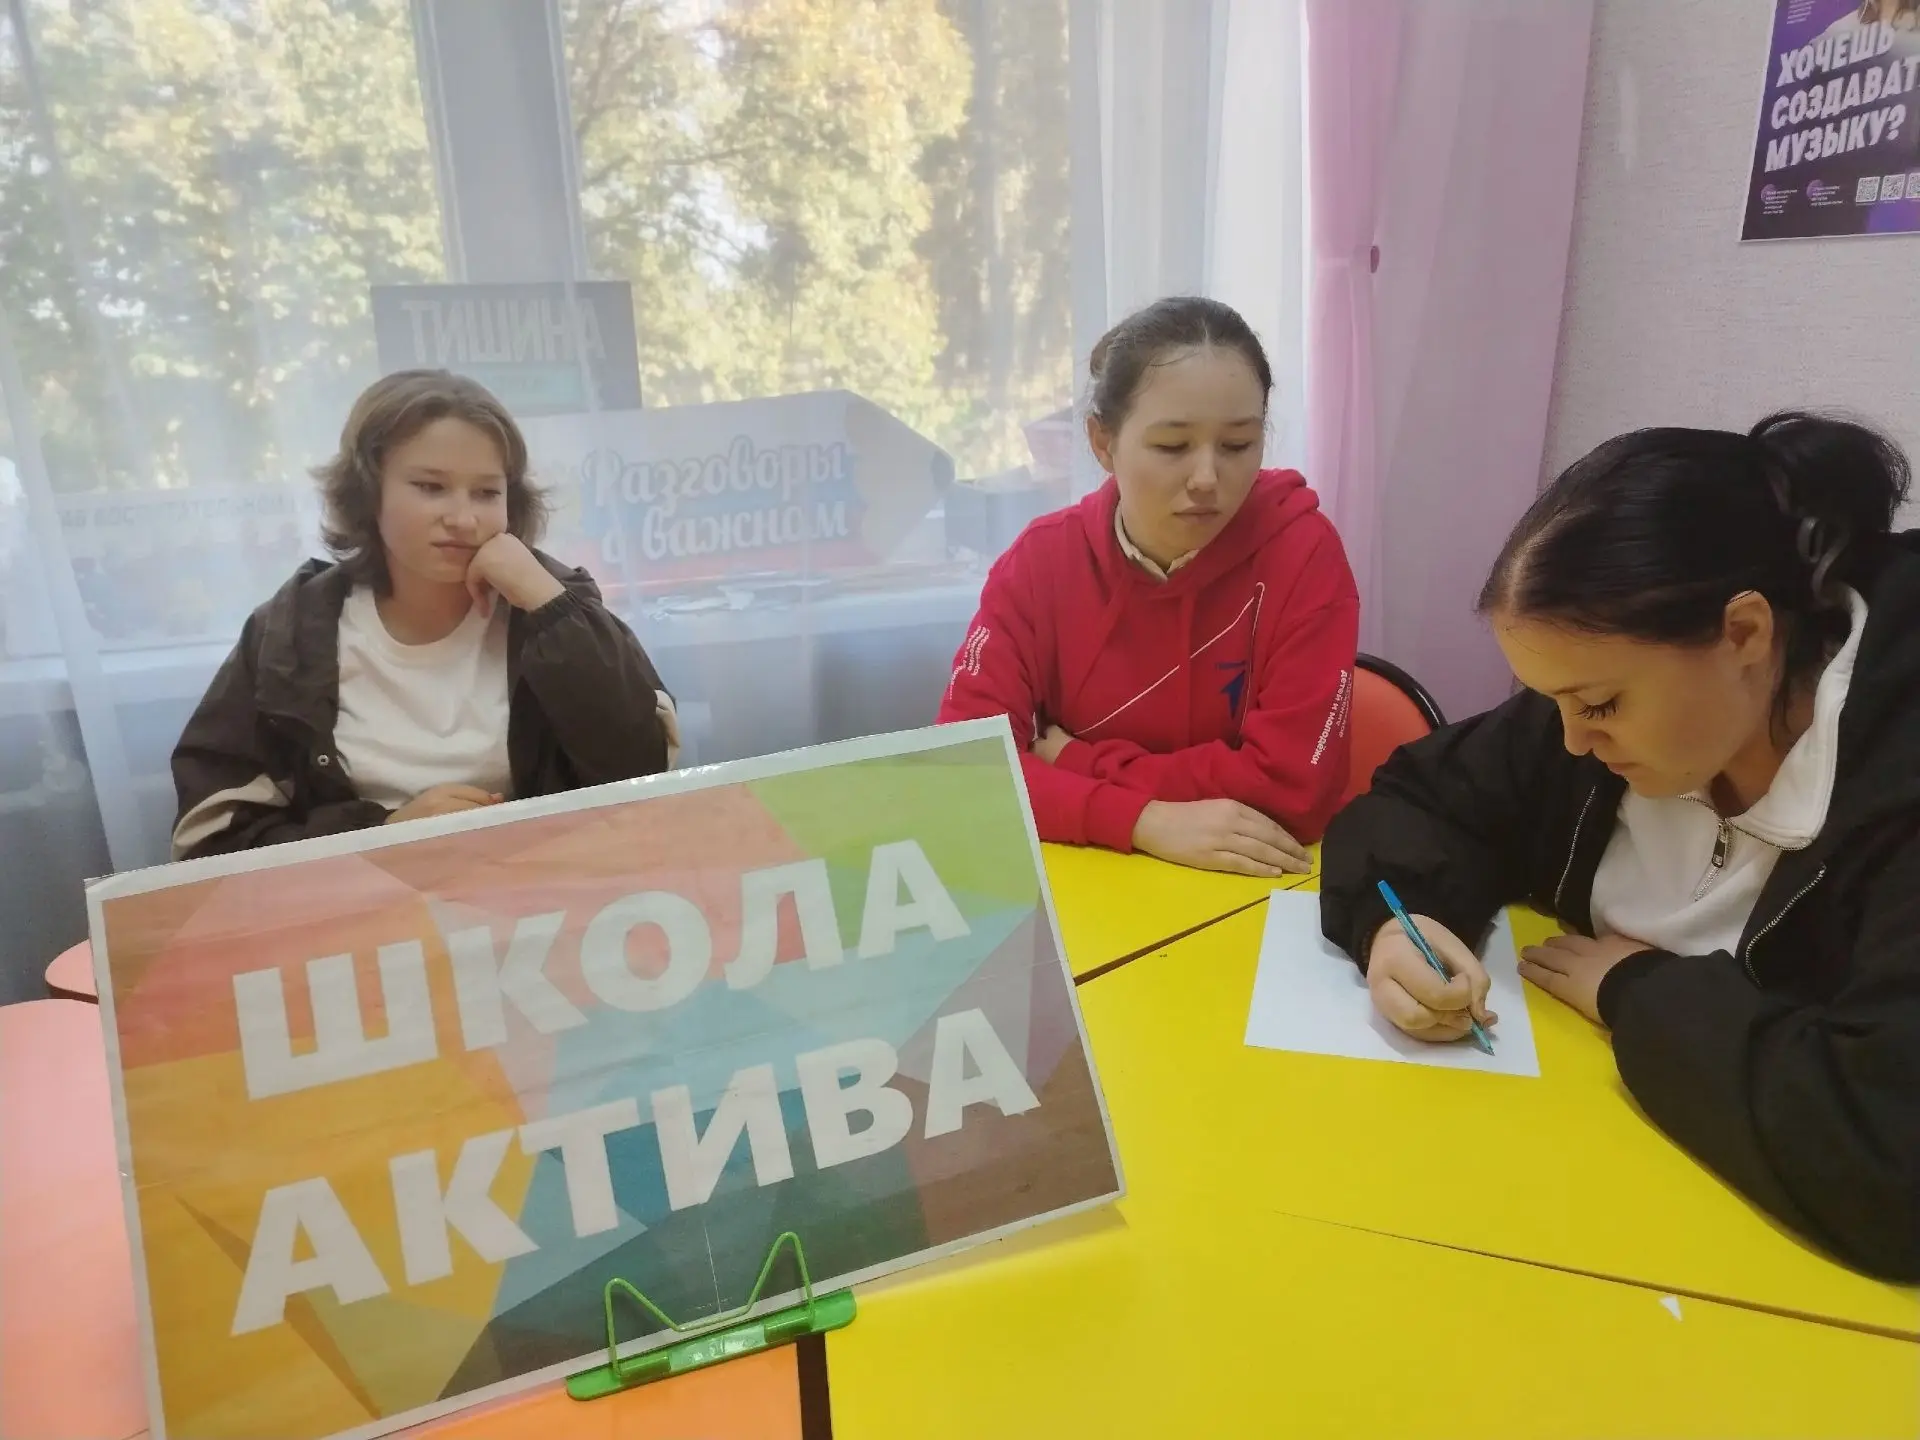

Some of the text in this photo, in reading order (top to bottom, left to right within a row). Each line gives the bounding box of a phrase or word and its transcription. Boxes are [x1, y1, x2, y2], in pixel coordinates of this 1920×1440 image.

[1776, 22, 1895, 87] ХОЧЕШЬ
[1771, 56, 1920, 130] СОЗДАВАТ
[1765, 104, 1906, 173] МУЗЫКУ?
[400, 298, 606, 364] ТИШИНА
[582, 434, 848, 518] Разговоры
[642, 501, 850, 561] важном
[1310, 669, 1348, 765] детей и молодёжи
[232, 839, 971, 1101] ШКОЛА
[231, 1007, 1041, 1337] АКТИВА
